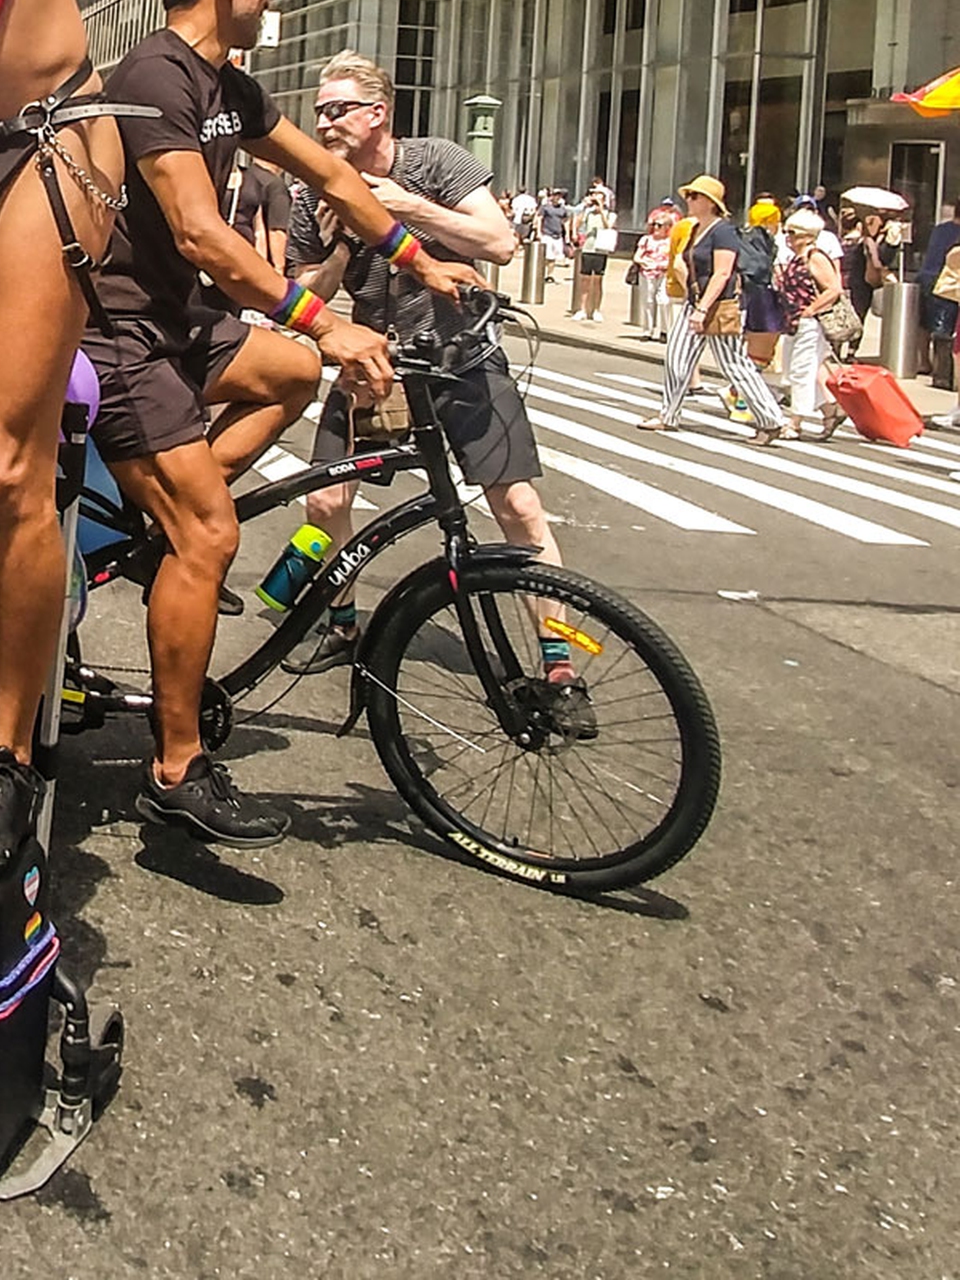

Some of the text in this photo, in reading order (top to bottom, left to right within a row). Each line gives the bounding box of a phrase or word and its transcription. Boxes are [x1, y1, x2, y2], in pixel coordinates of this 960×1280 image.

[327, 542, 372, 587] yuba
[447, 831, 548, 883] ALL TERRAIN
